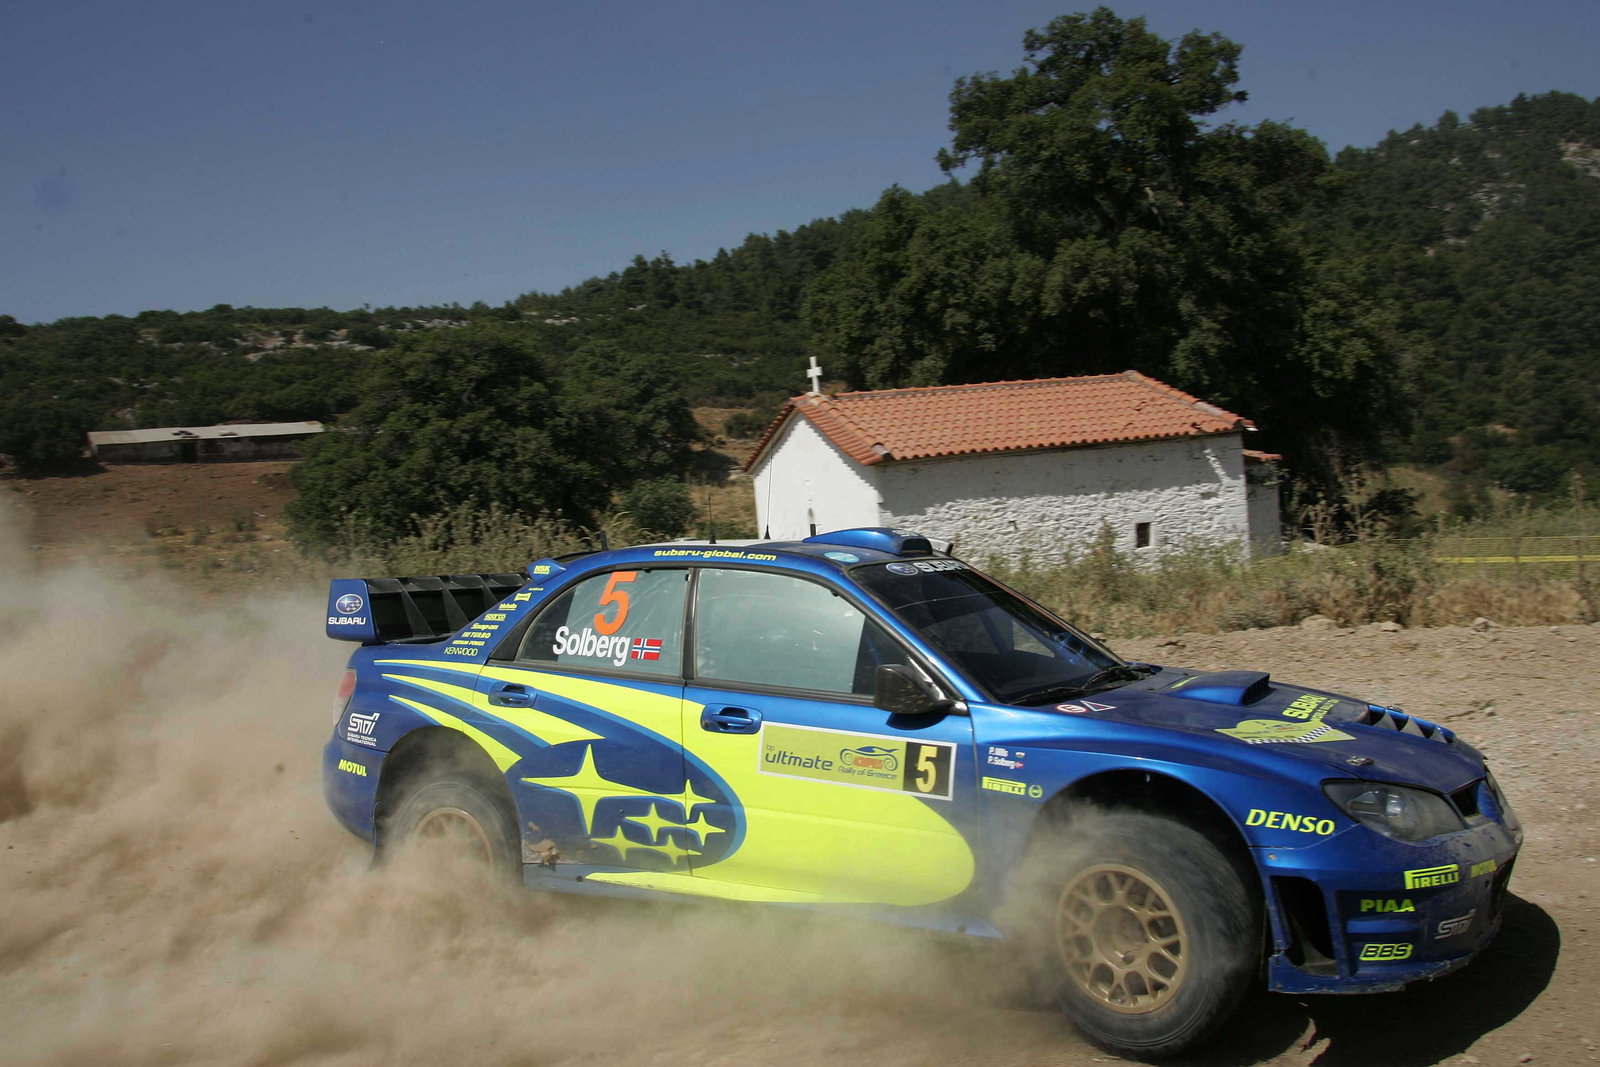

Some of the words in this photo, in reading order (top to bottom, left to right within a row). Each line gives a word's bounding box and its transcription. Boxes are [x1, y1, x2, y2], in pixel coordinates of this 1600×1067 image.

[653, 549, 777, 561] subaru-global.com
[913, 560, 969, 572] SUBAR
[593, 571, 638, 636] 5
[328, 616, 366, 625] SUBARU
[444, 646, 478, 657] KENWOOD
[552, 625, 631, 667] Solberg
[1282, 693, 1327, 719] SUBAR
[338, 758, 367, 777] MOTUL
[765, 750, 833, 771] ultimate
[915, 745, 938, 793] 5
[982, 776, 1026, 795] PIRELLI
[1245, 808, 1335, 836] DENSO
[1404, 864, 1459, 889] PIRELLI
[1360, 898, 1415, 913] PIAA
[1359, 943, 1413, 961] BBS
